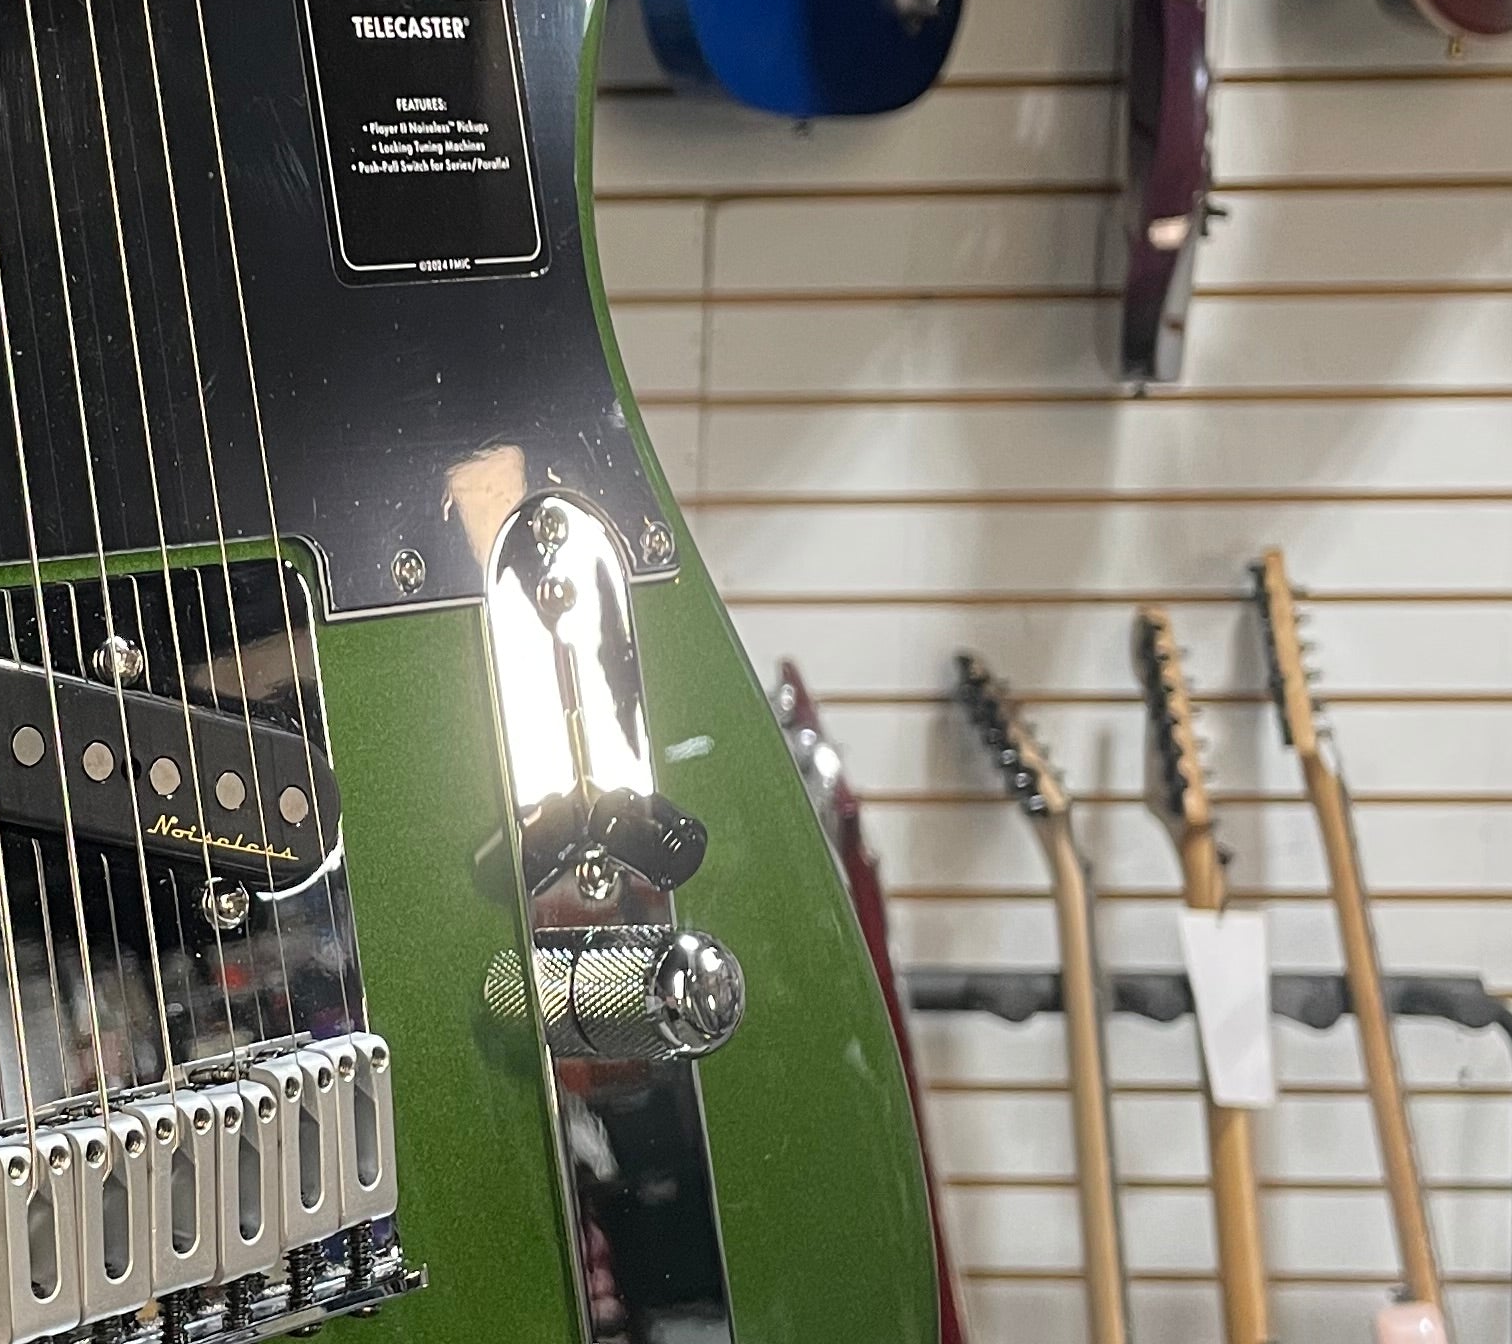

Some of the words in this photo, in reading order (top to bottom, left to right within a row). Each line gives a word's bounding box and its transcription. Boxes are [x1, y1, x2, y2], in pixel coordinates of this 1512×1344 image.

[396, 97, 448, 112] FEATURES:
[369, 121, 398, 137] Player
[378, 140, 413, 156] Locking
[413, 140, 443, 155] Tuning
[445, 138, 485, 152] Machines
[400, 158, 429, 172] Switch
[429, 158, 444, 171] for
[146, 814, 300, 861] Noiseless
